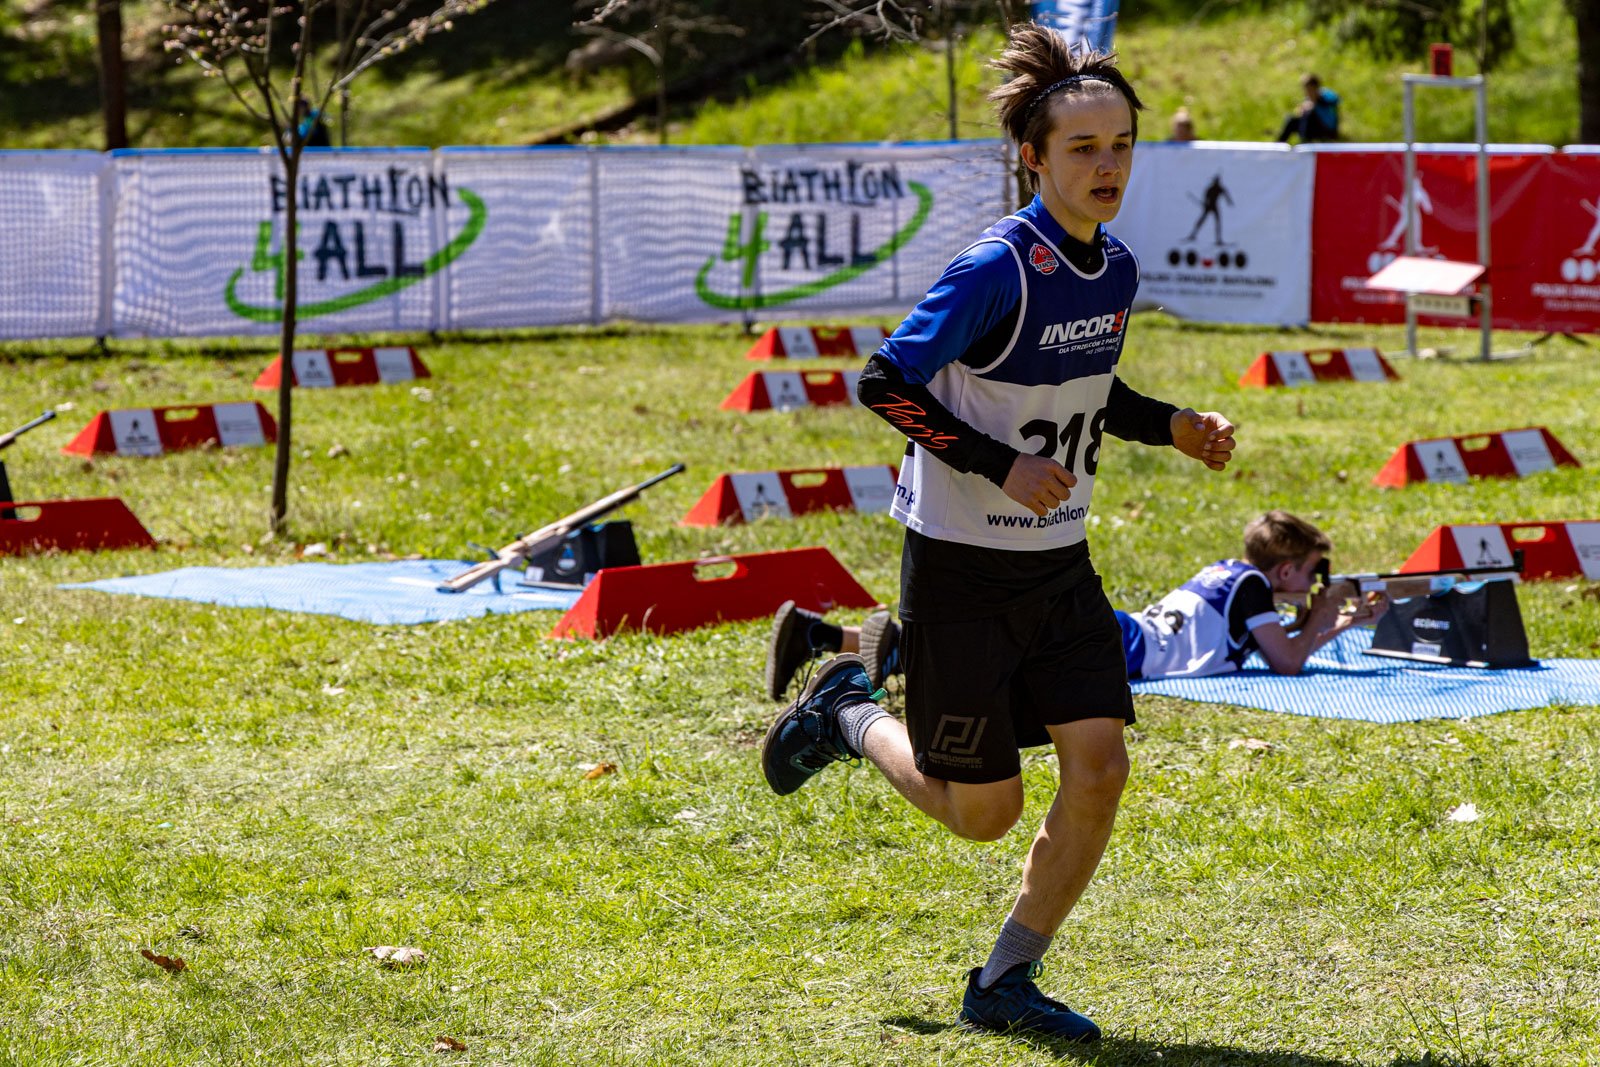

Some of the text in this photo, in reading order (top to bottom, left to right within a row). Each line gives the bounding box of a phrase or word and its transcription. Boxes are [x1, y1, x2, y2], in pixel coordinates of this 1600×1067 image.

[741, 159, 904, 207] BIATHLON
[252, 220, 426, 300] 4 ALL
[721, 212, 877, 288] 4 ALL
[1058, 346, 1070, 354] DLA
[1019, 407, 1105, 476] 218
